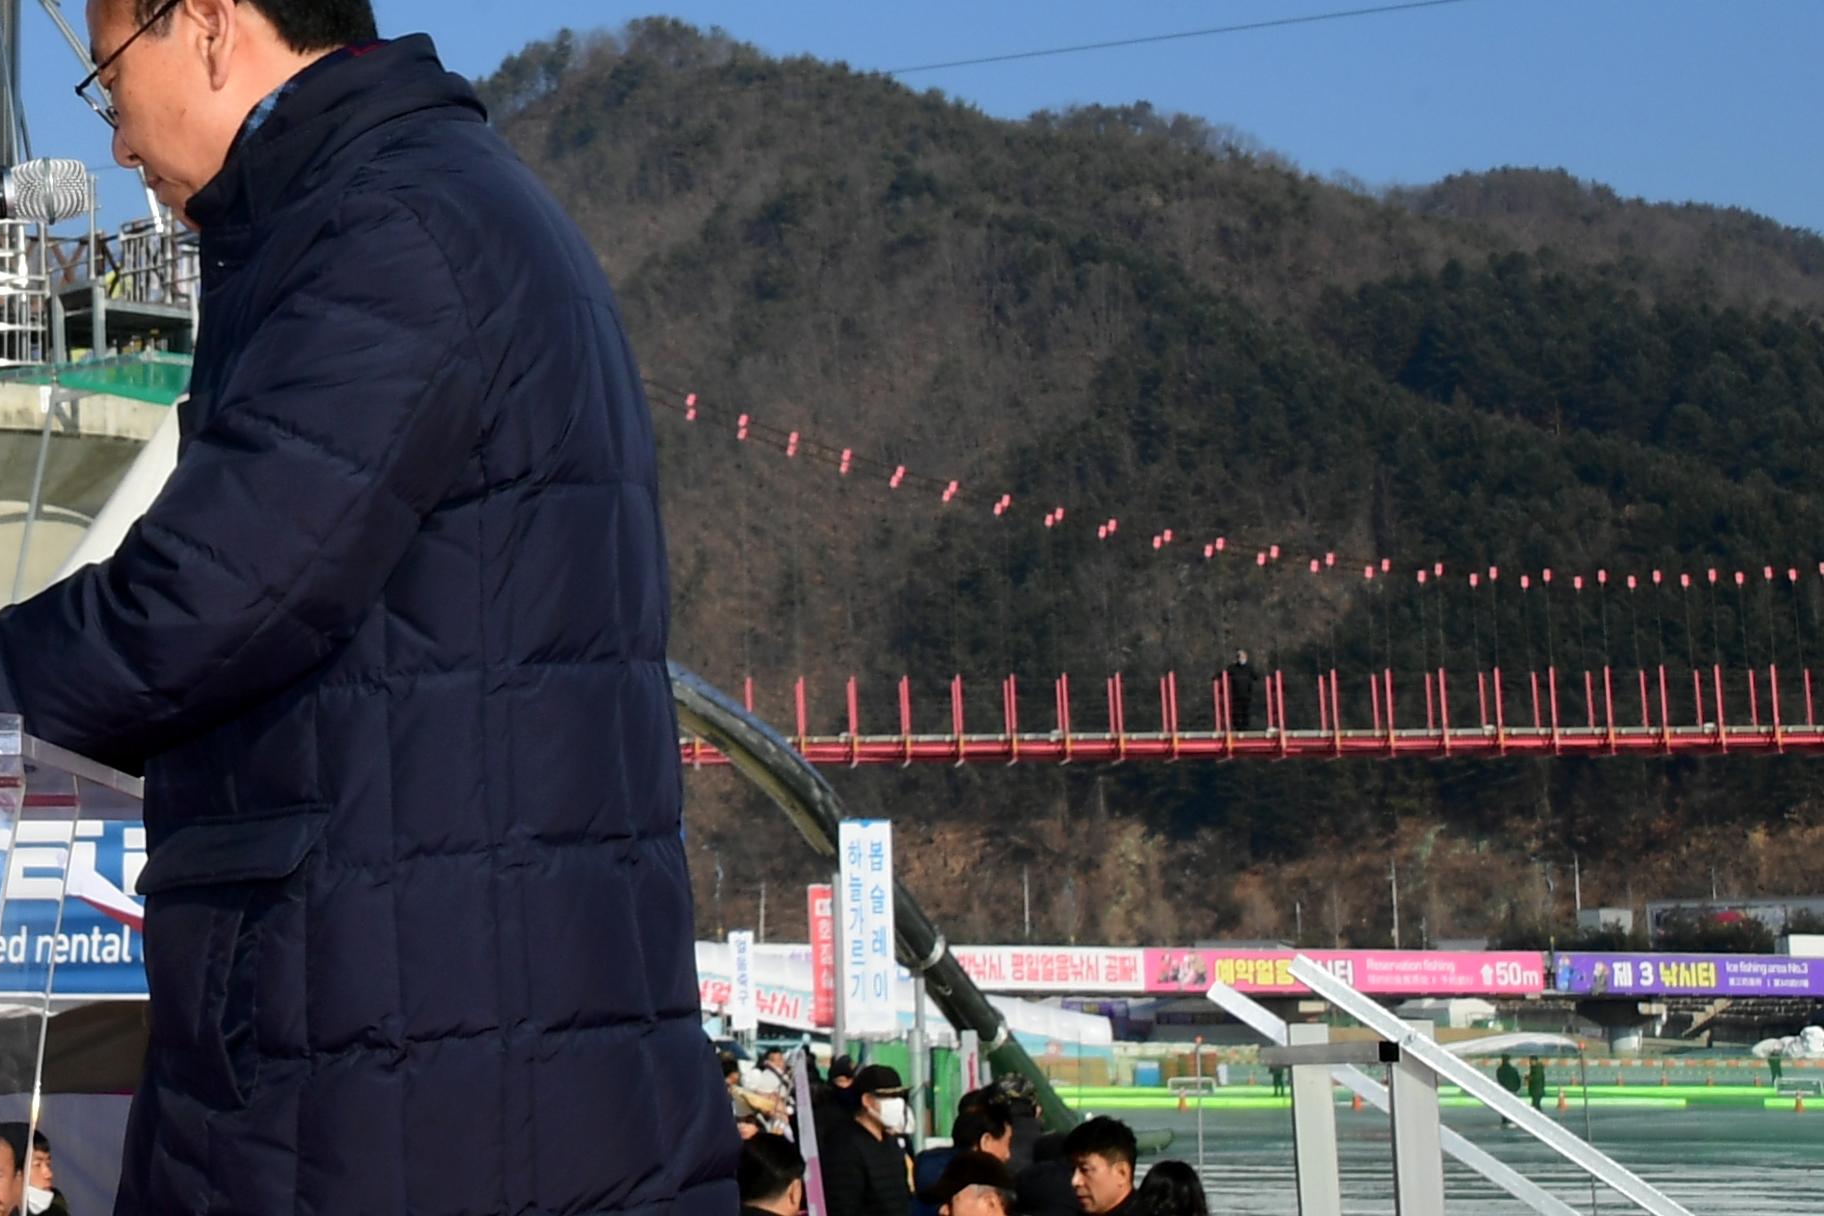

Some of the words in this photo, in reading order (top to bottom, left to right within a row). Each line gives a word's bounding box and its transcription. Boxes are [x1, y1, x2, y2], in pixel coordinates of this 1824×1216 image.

[35, 925, 132, 964] rental
[1215, 958, 1354, 986] 예약얼음터
[1495, 961, 1539, 986] 50m
[1612, 961, 1632, 988] 제
[1639, 961, 1654, 986] 3
[1659, 962, 1716, 988] 낚시터
